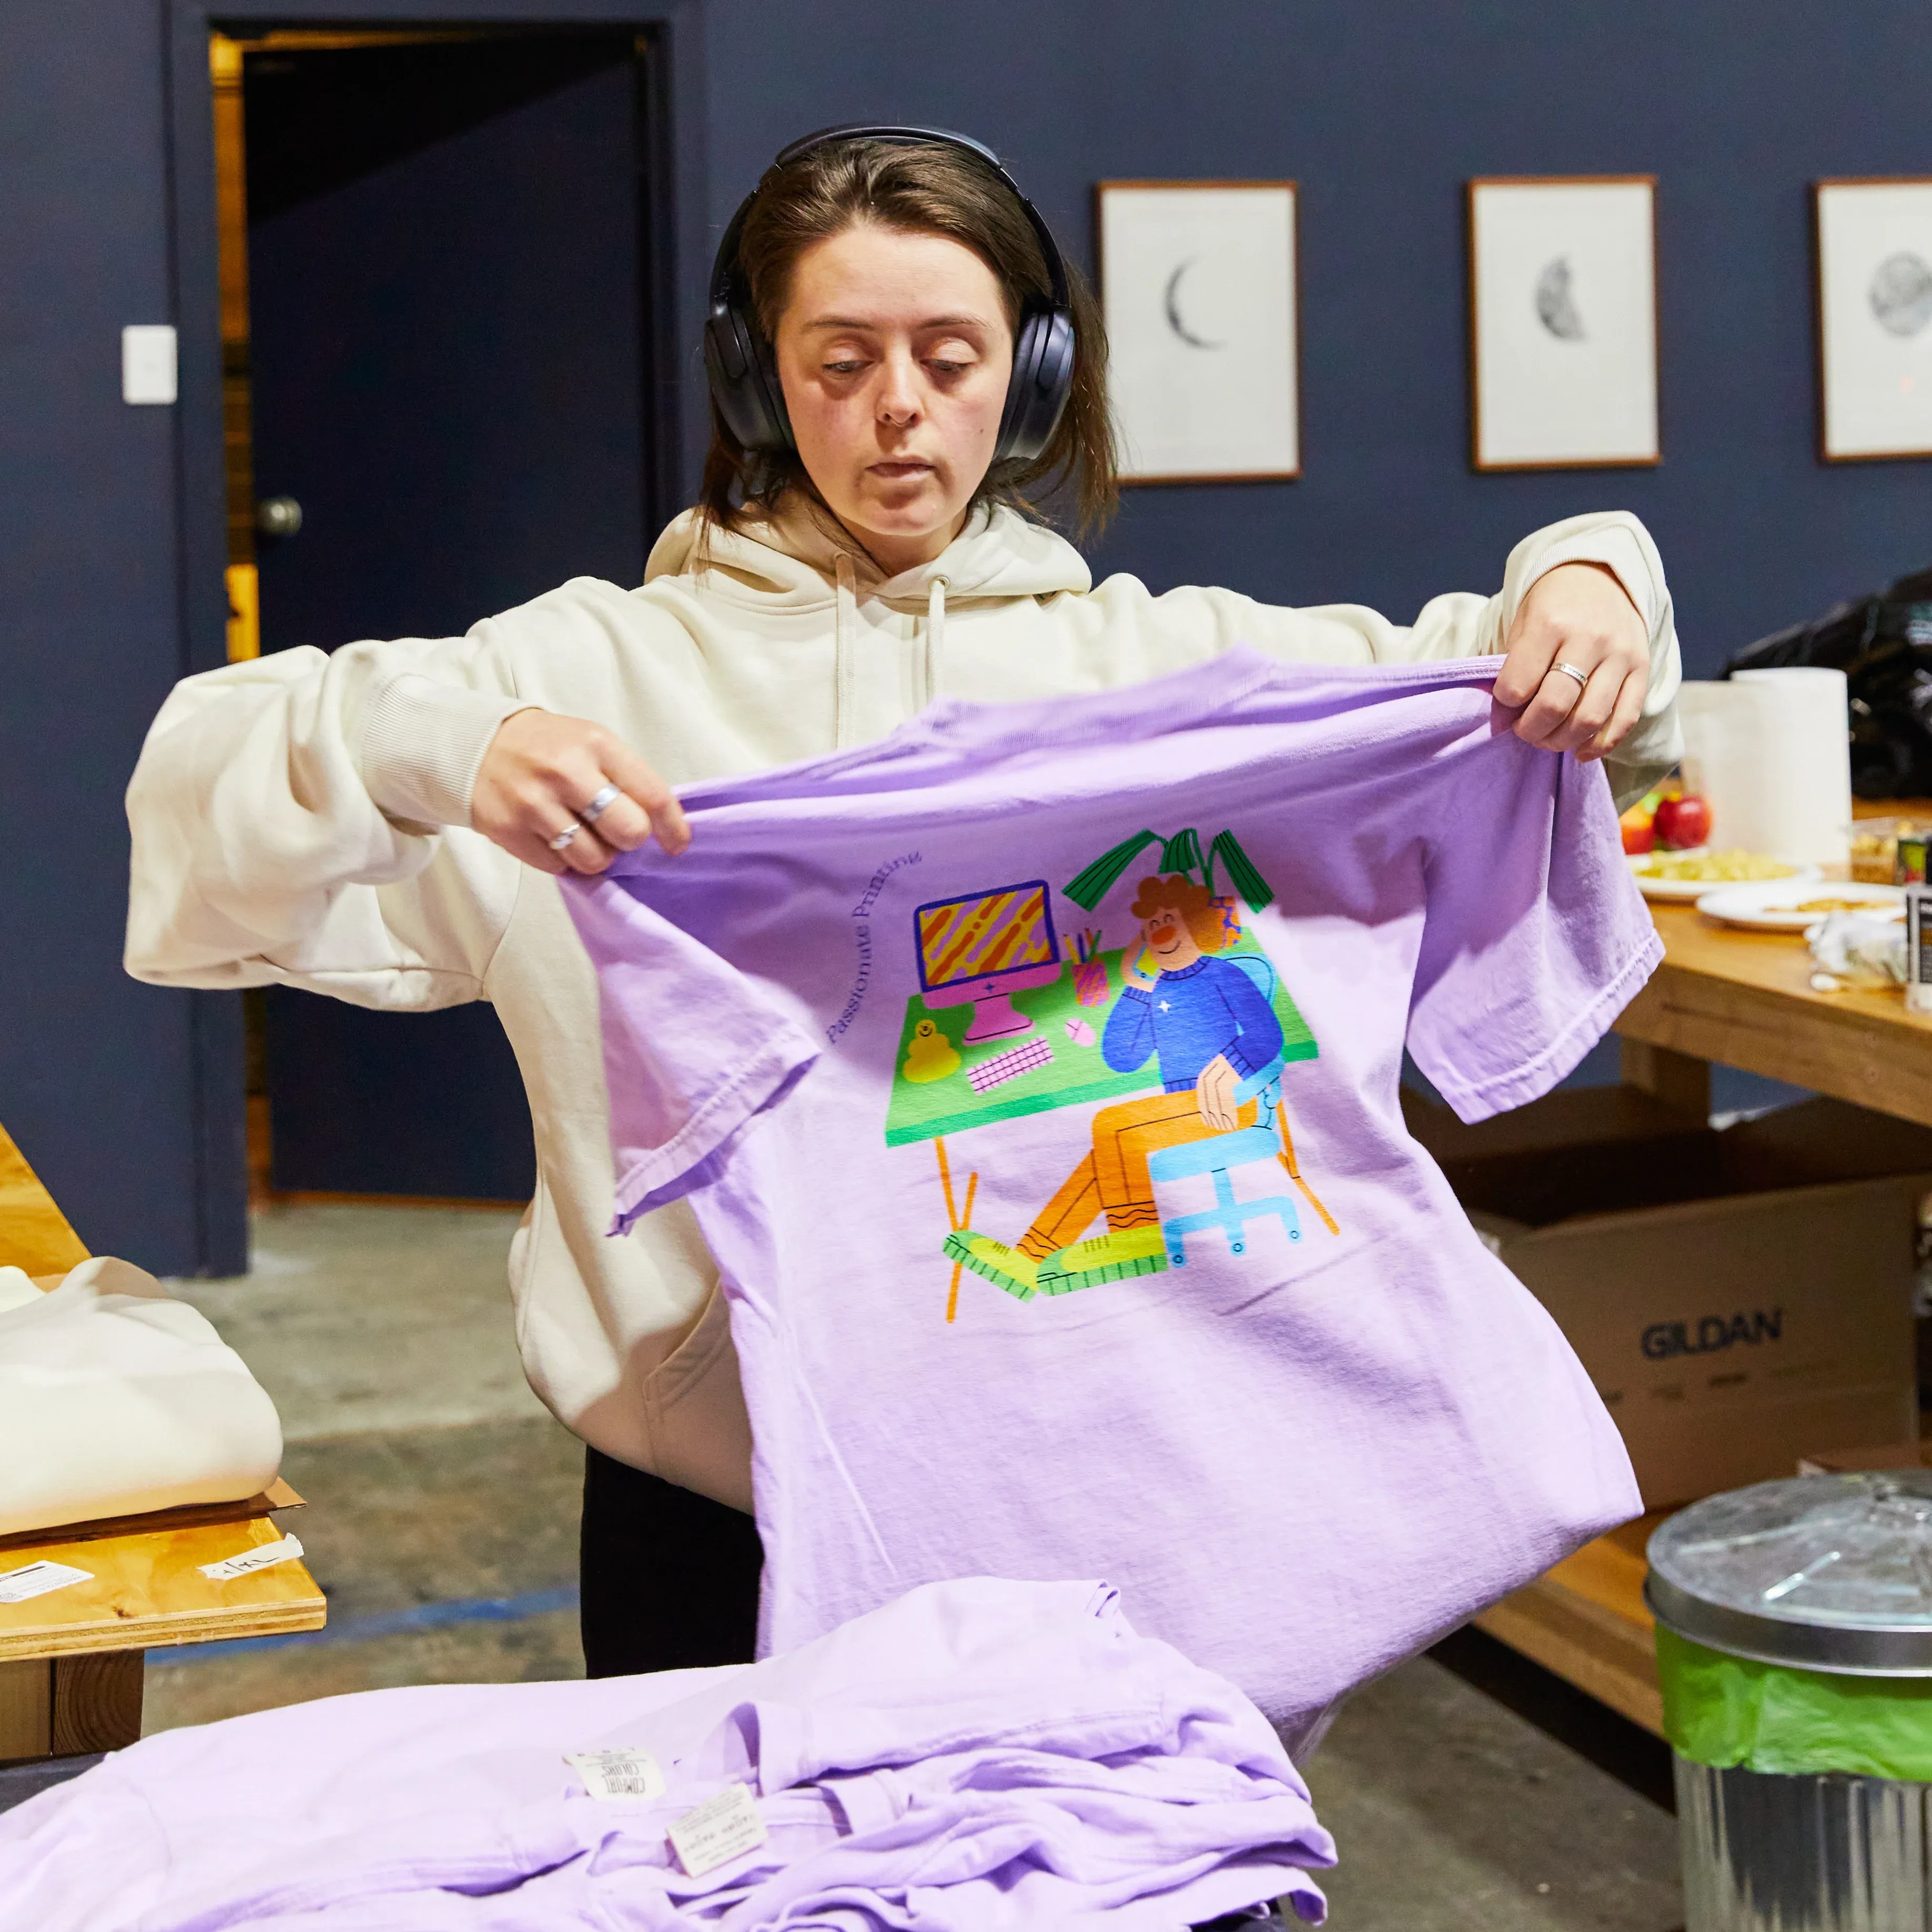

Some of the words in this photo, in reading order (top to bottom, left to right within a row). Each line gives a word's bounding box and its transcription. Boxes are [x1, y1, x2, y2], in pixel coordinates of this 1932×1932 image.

[826, 925, 872, 1044] Passionate
[851, 851, 923, 917] Printing
[1640, 1308, 1783, 1360] GILDAN
[602, 1763, 640, 1776] COLORS
[605, 1777, 645, 1794] COMFORT
